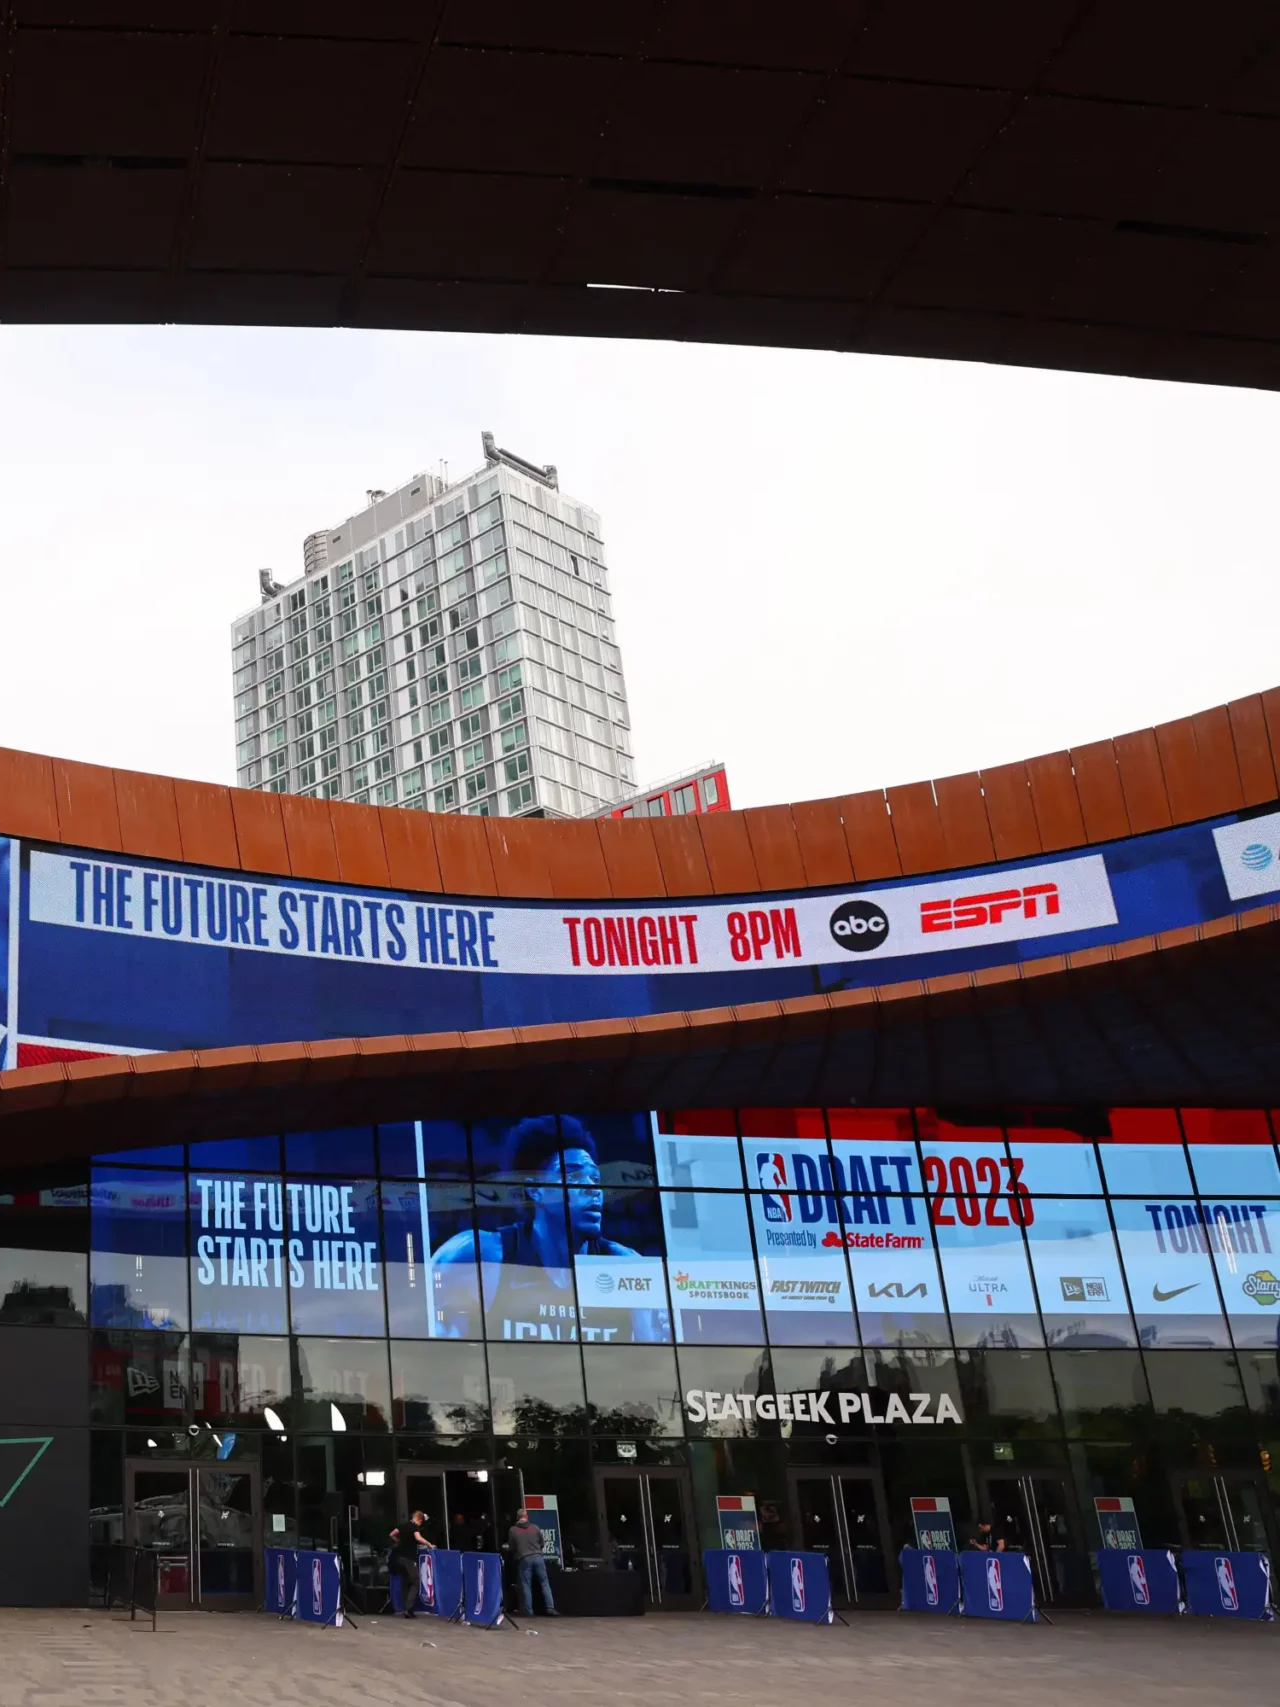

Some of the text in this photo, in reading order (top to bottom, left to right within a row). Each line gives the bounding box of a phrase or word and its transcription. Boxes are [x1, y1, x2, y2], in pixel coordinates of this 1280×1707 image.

[70, 862, 499, 967] THE FUTURE STARTS HERE
[833, 915, 885, 936] abc
[920, 882, 1060, 933] ESPN
[563, 907, 802, 967] TONIGHT 8PM
[197, 1179, 355, 1234] THE FUTURE
[767, 1206, 783, 1219] NBA
[792, 1153, 917, 1226] DRAFT
[923, 1155, 1035, 1227] 2023
[766, 1229, 817, 1249] Presented by
[1145, 1204, 1273, 1254] TONIGHT
[198, 1235, 378, 1291] STARTS HERE
[618, 1277, 652, 1291] AT&T
[969, 1283, 1008, 1293] ULTRA
[689, 1290, 749, 1299] SPORTSBOOK
[686, 1390, 963, 1424] SEATGEEK PLAZA
